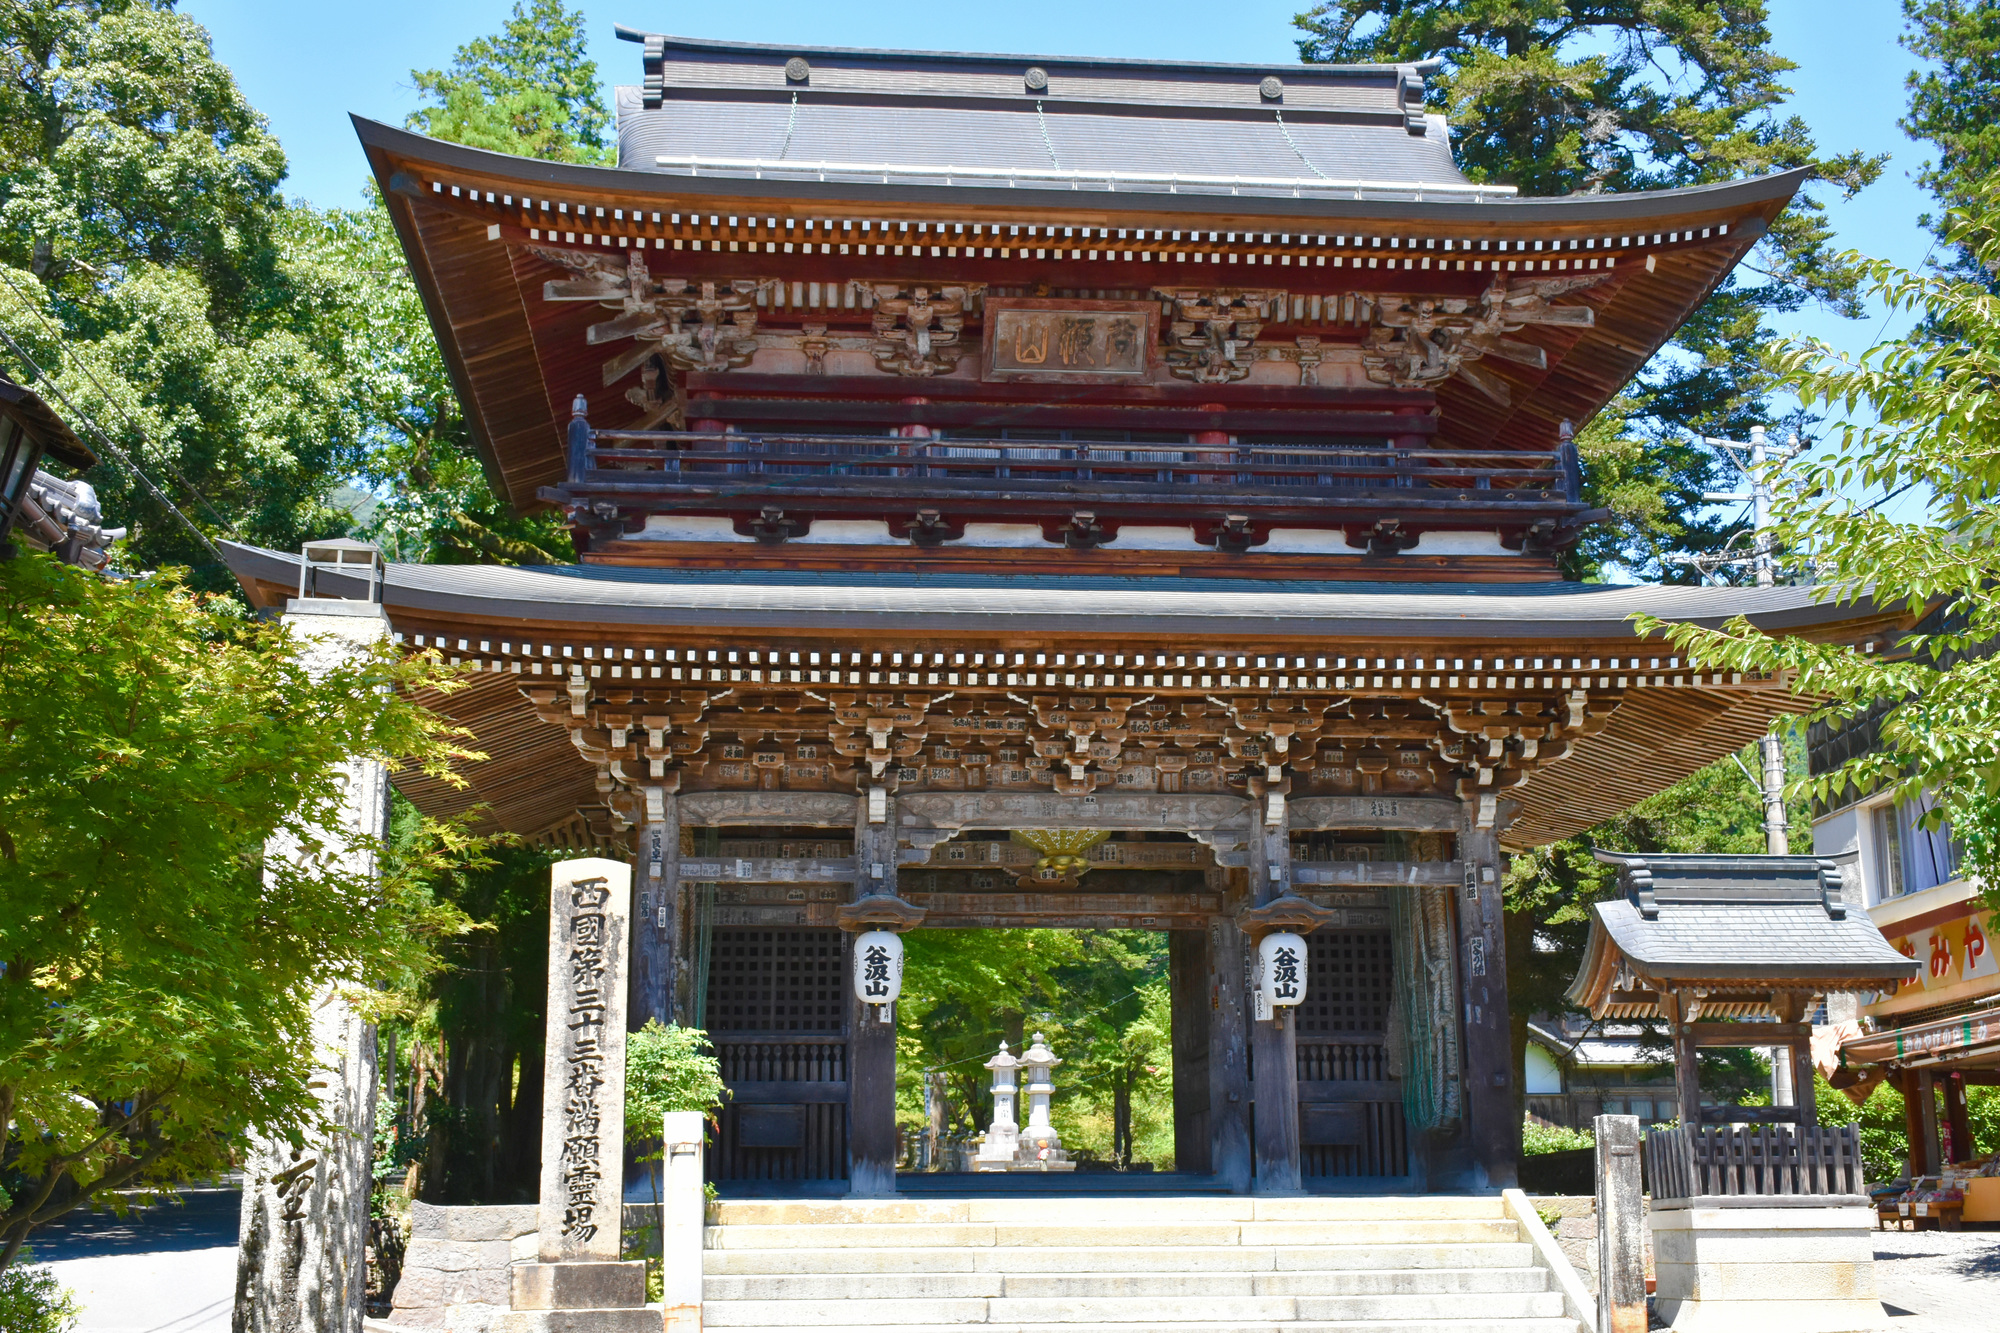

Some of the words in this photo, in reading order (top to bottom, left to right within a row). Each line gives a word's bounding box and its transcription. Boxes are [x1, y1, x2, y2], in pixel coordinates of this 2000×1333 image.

[864, 945, 892, 997] 谷汲山
[1273, 946, 1300, 999] 谷汲山
[1905, 1025, 1961, 1052] おみやげの店
